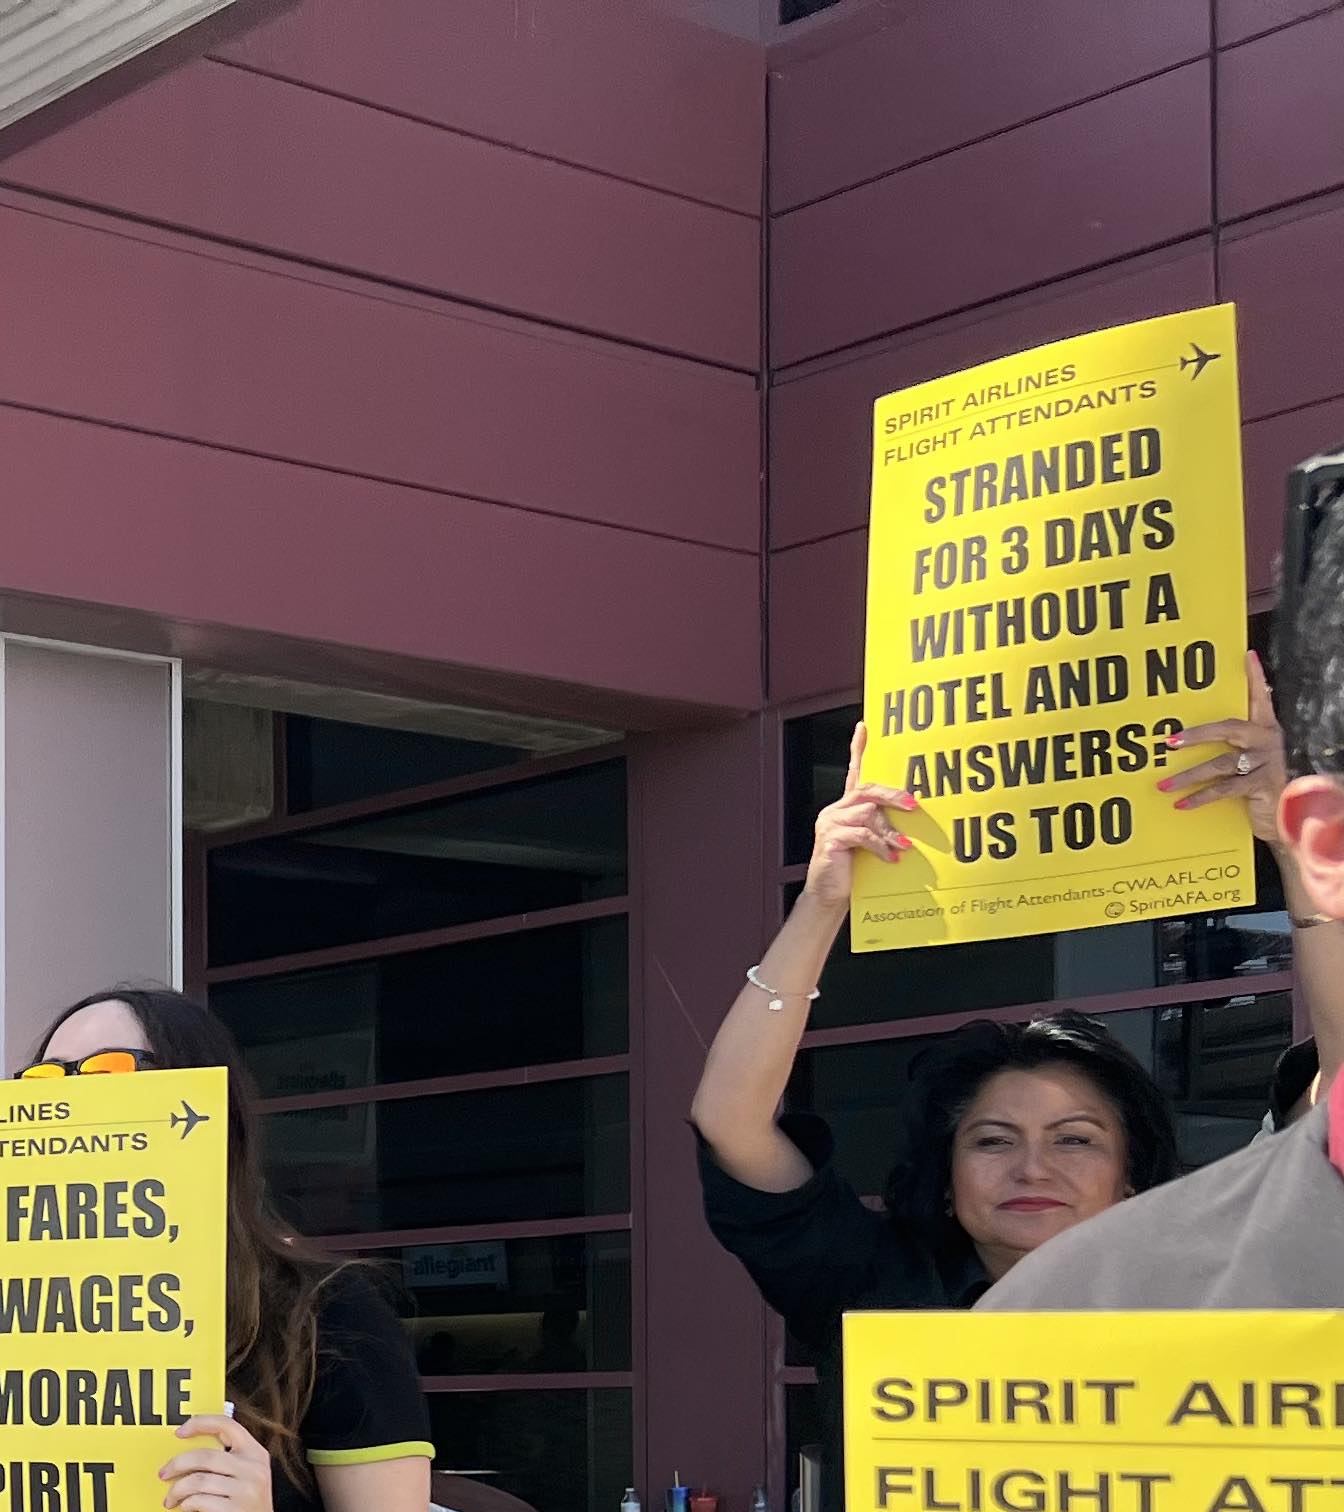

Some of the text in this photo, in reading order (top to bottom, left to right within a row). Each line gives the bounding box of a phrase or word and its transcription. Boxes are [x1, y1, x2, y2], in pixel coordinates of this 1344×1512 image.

[883, 379, 1158, 467] FLIGHT ATTENDANTS
[884, 363, 1077, 435] SPIRIT AIRLINES
[923, 426, 1162, 524] STRANDED
[913, 498, 1176, 596] FOR 3 DAYS
[910, 572, 1180, 664] WITHOUT A
[881, 640, 1217, 738] HOTEL AND NO
[906, 716, 1185, 800] ANSWERS?
[953, 796, 1133, 865] US TOO
[861, 904, 945, 924] Association
[950, 900, 968, 915] of
[970, 896, 1014, 917] Flight
[1166, 864, 1241, 887] AFL-CIO
[1129, 887, 1241, 914] SpiritAFA.org
[6, 1178, 180, 1246] FARES,
[871, 1377, 1344, 1429] SPIRIT AIR
